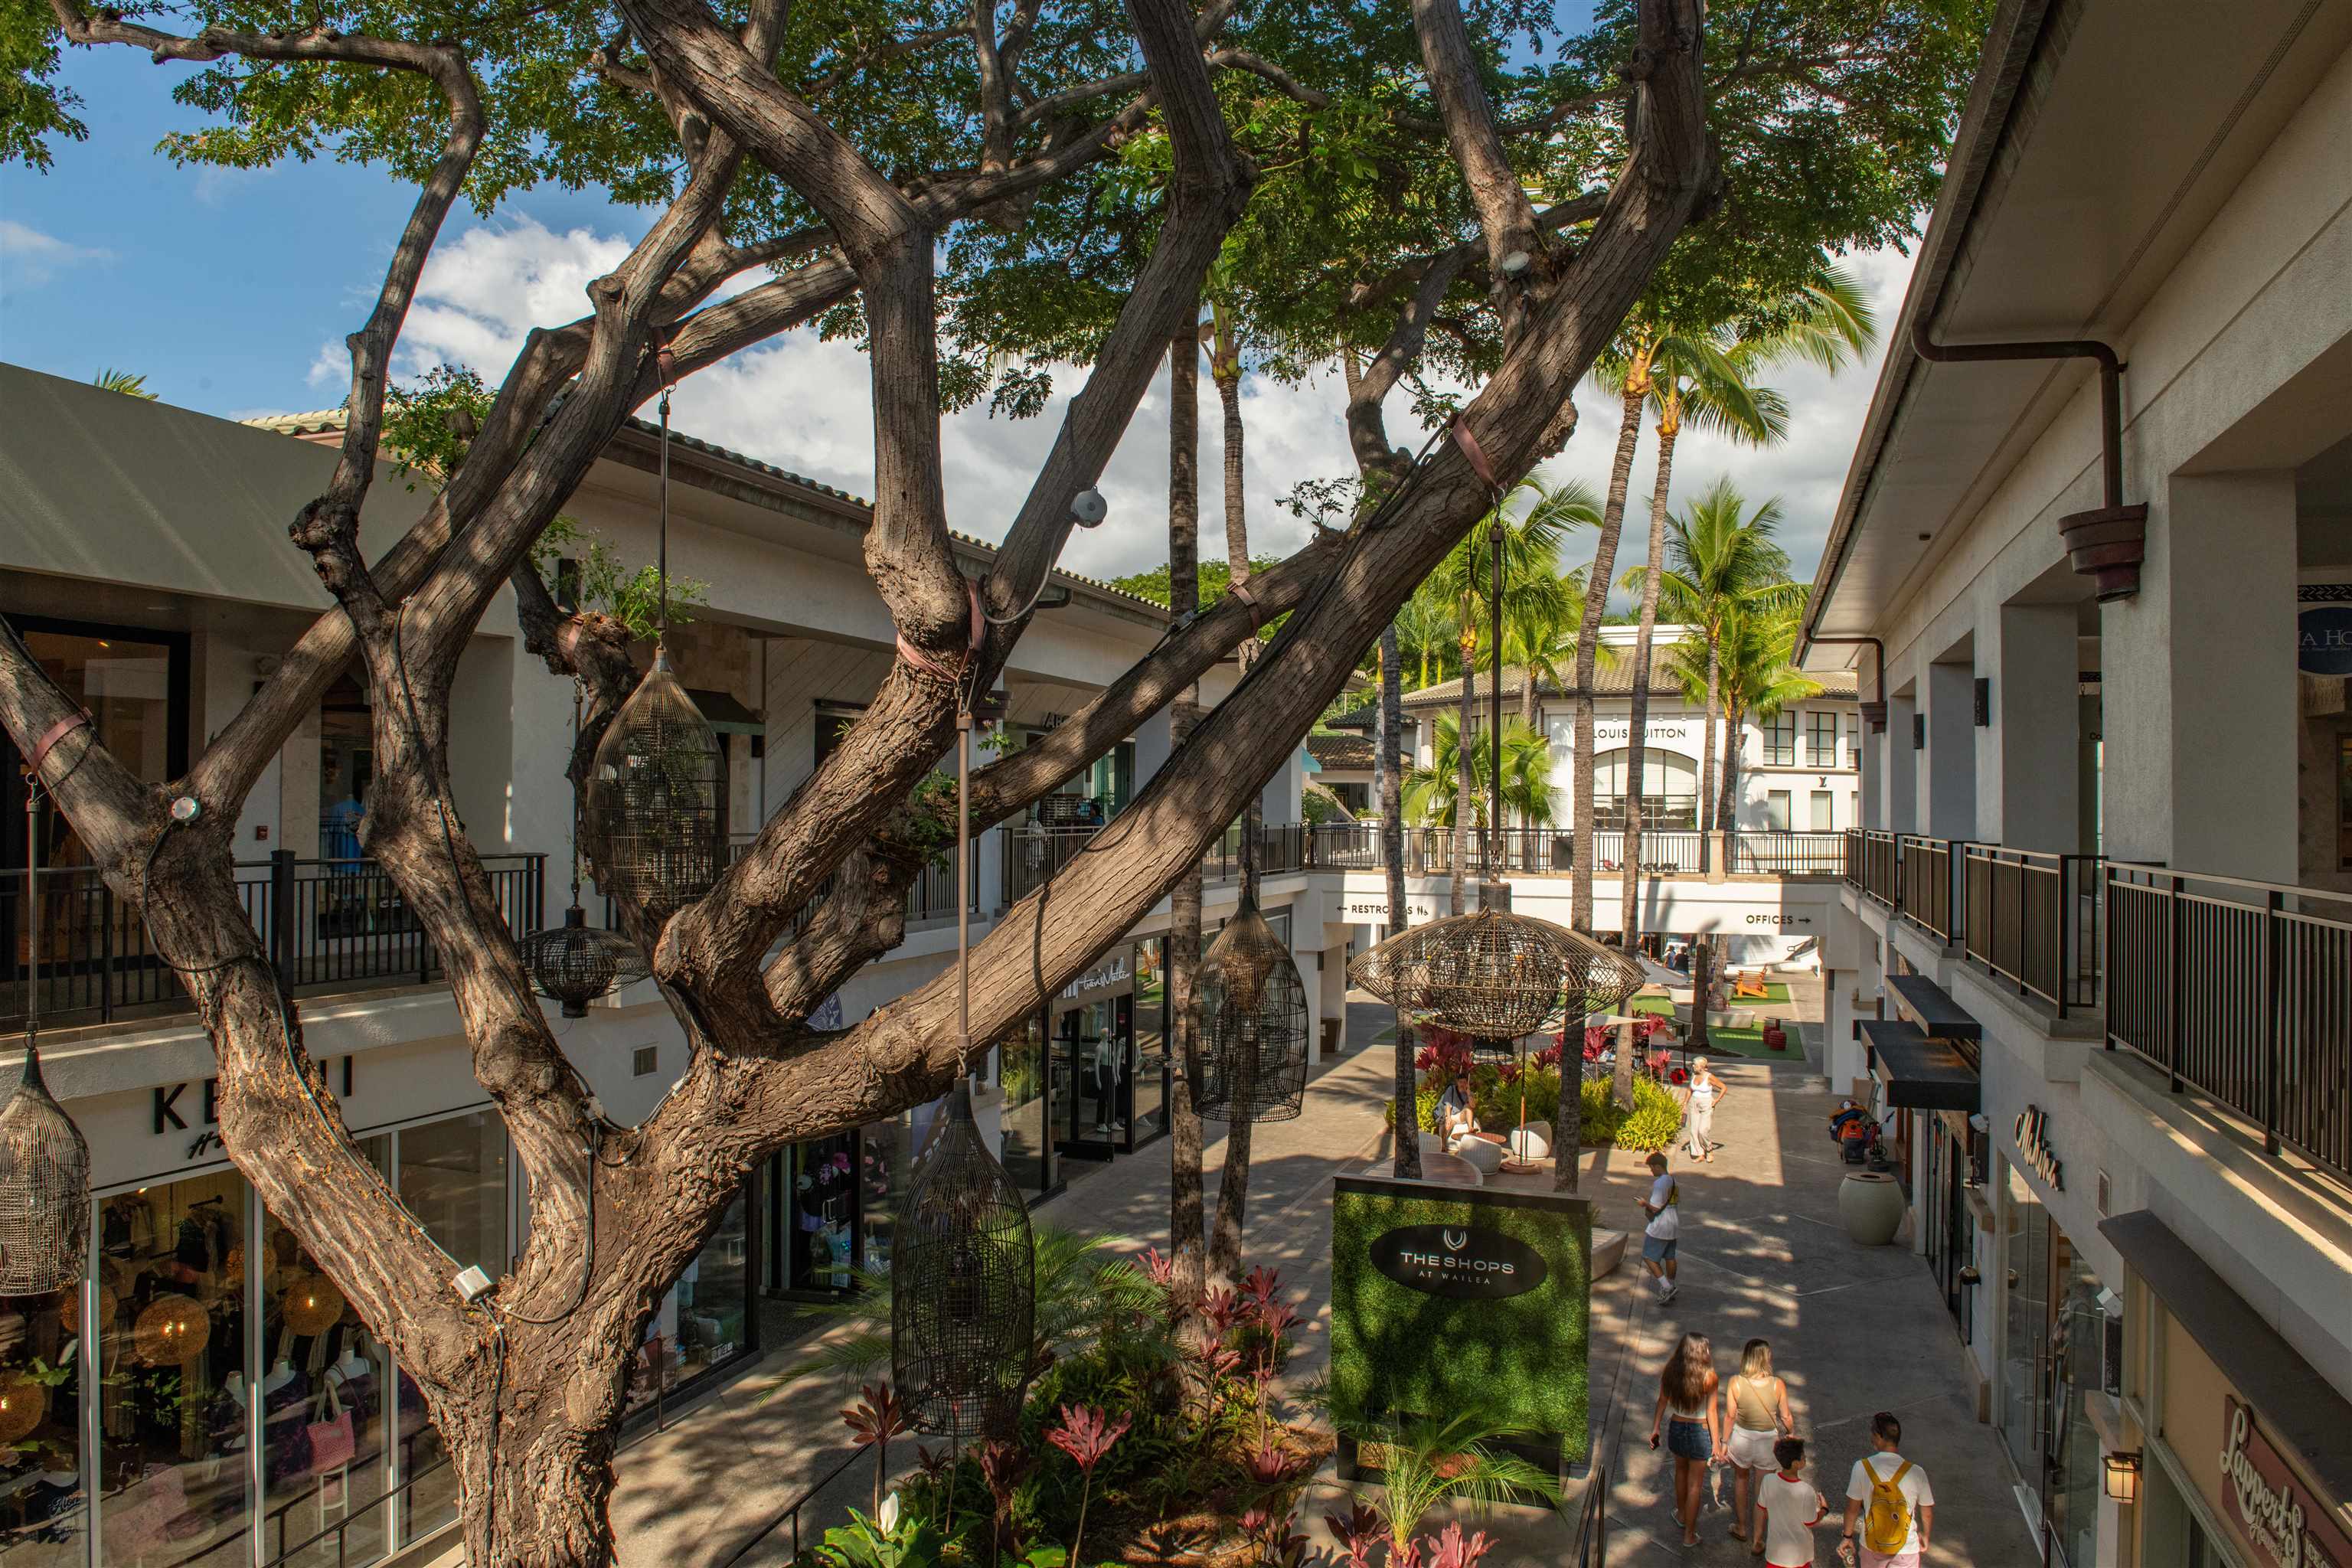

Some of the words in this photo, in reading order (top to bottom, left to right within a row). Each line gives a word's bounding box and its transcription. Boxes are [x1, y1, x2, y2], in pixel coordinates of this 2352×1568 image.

[1351, 905, 1413, 915] RESTROS
[1746, 915, 1793, 925] OFFICES
[1400, 1252, 1440, 1266] THE
[1444, 1256, 1514, 1274] SHOPS
[1442, 1272, 1491, 1285] WAILEA
